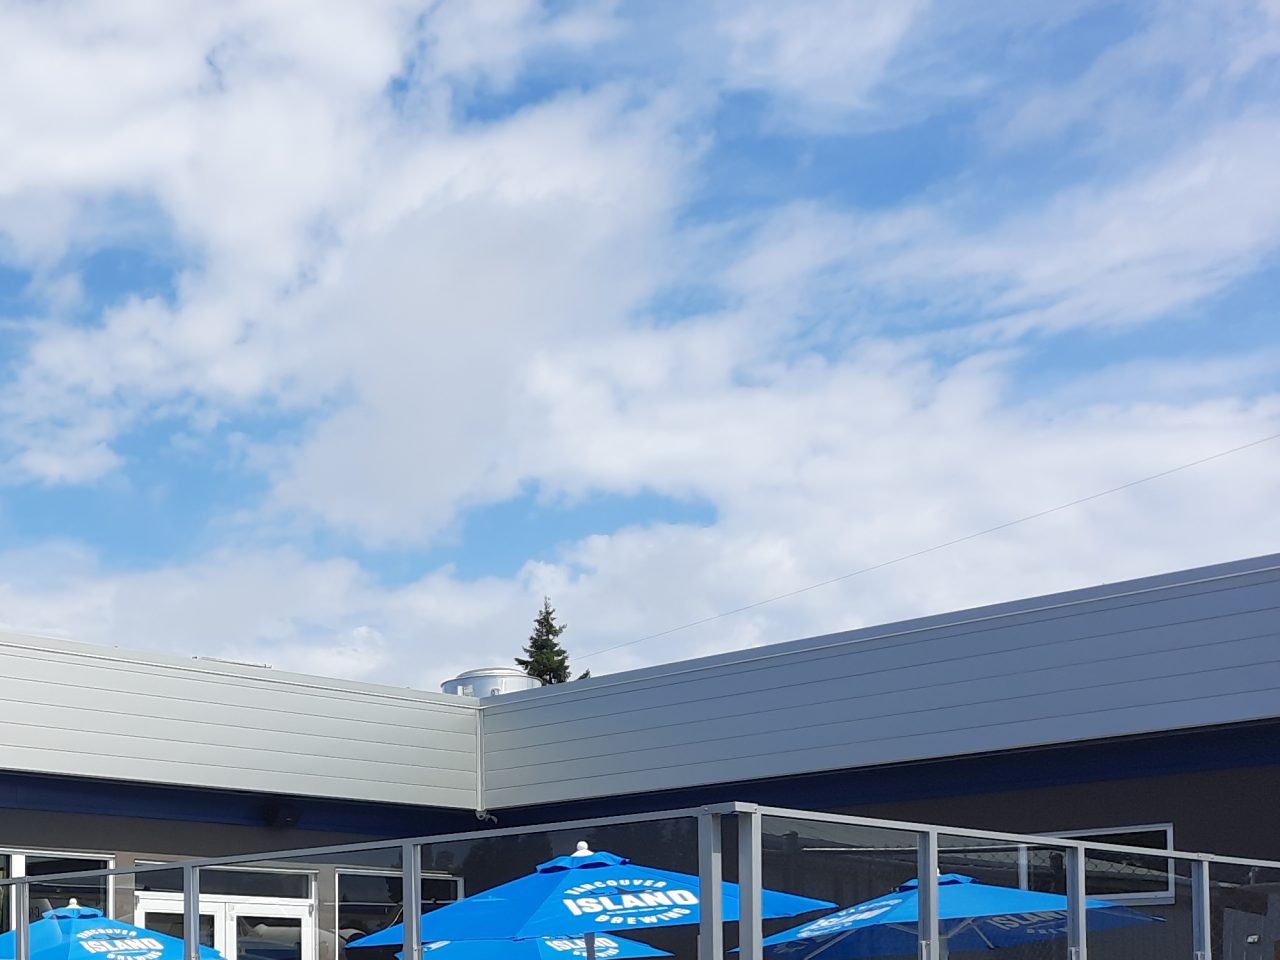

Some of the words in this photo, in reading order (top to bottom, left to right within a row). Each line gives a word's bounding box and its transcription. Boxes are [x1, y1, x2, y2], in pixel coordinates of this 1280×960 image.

[564, 879, 668, 896] VANCOUVER
[562, 889, 699, 917] ISLAND
[594, 907, 692, 925] BREWING
[79, 937, 165, 954] ISLAND
